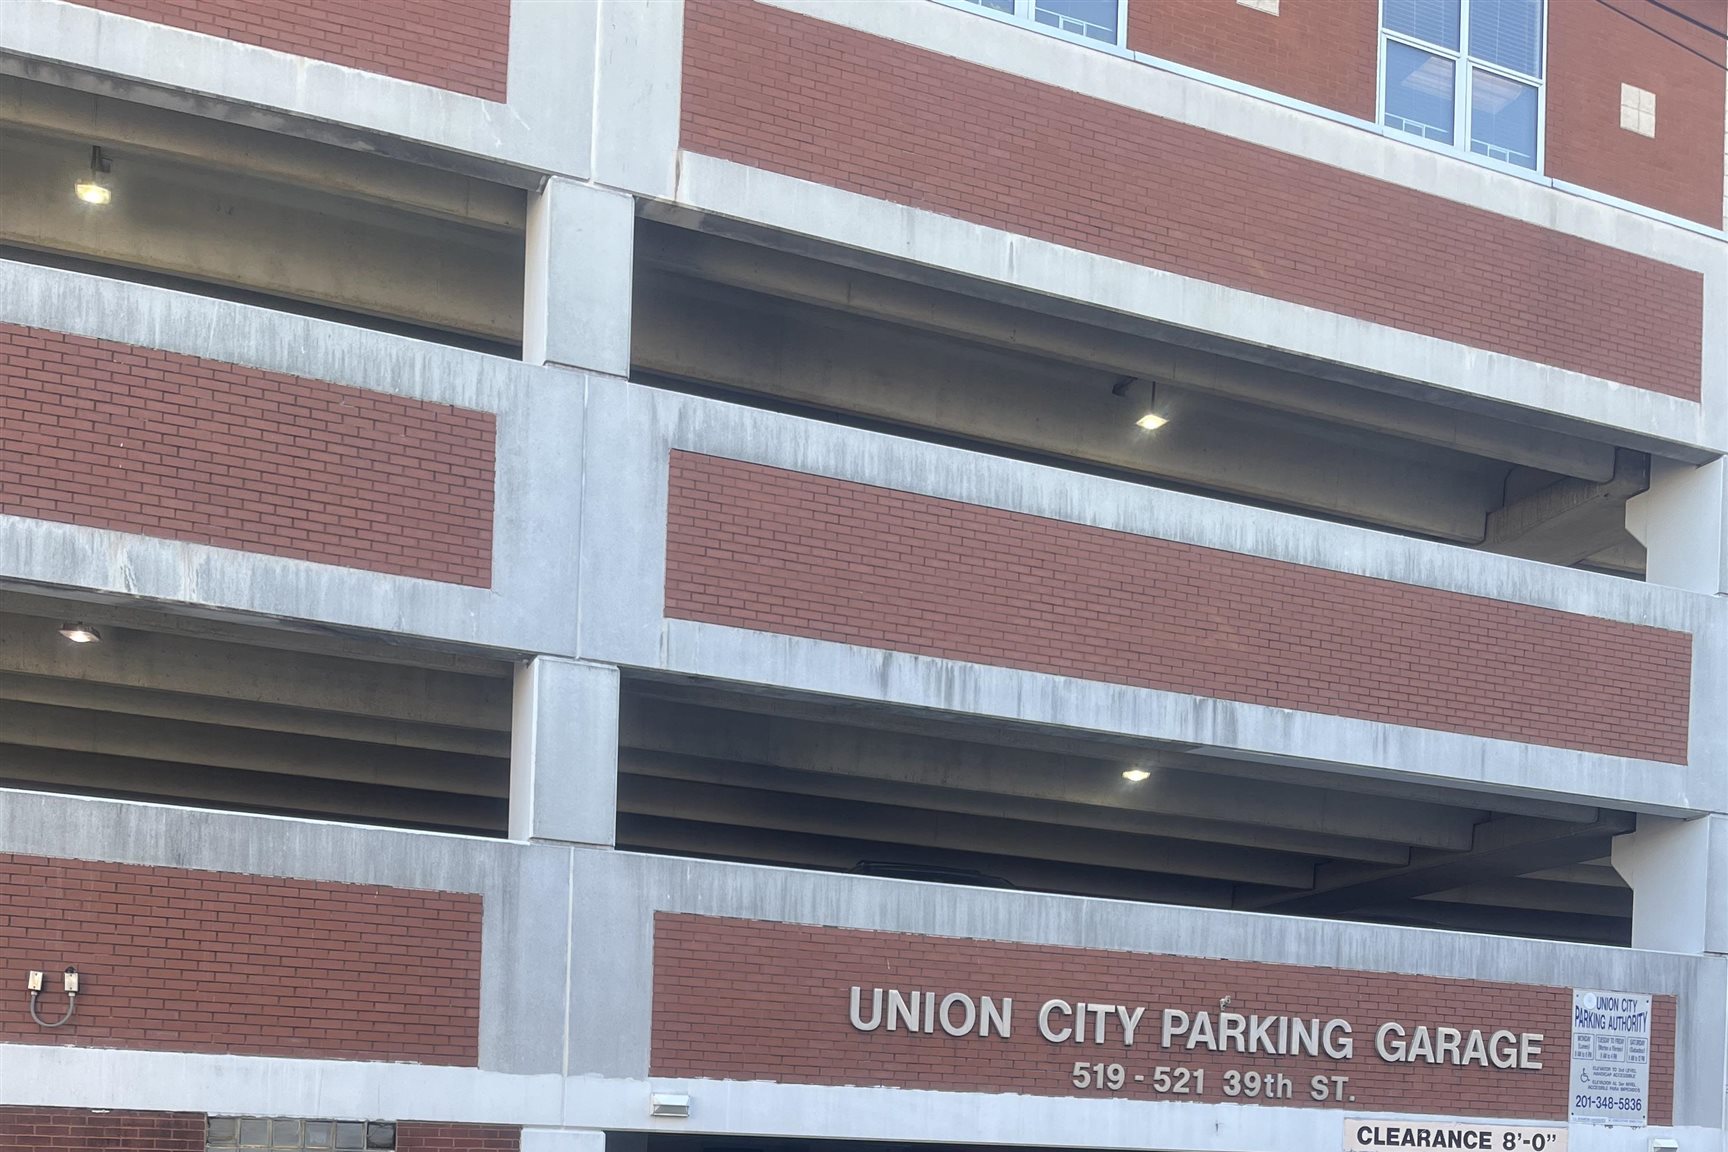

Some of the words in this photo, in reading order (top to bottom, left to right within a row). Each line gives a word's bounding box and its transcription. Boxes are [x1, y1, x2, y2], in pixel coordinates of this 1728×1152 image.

[1596, 997, 1619, 1011] UNION
[1621, 999, 1638, 1013] CITY
[850, 986, 1012, 1038] UNION
[1039, 999, 1146, 1046] CITY
[1161, 1008, 1353, 1059] PARKING
[1375, 1021, 1544, 1070] GARAGE
[1575, 1005, 1606, 1029] PARKING
[1608, 1011, 1648, 1032] AUTHORITY
[1072, 1062, 1126, 1090] 519
[1134, 1074, 1145, 1082] -
[1153, 1066, 1204, 1095] 521
[1223, 1070, 1293, 1099] 39th
[1310, 1075, 1356, 1102] ST.
[1575, 1095, 1642, 1111] 201-348-5836
[1356, 1126, 1493, 1150] CLEARANCE
